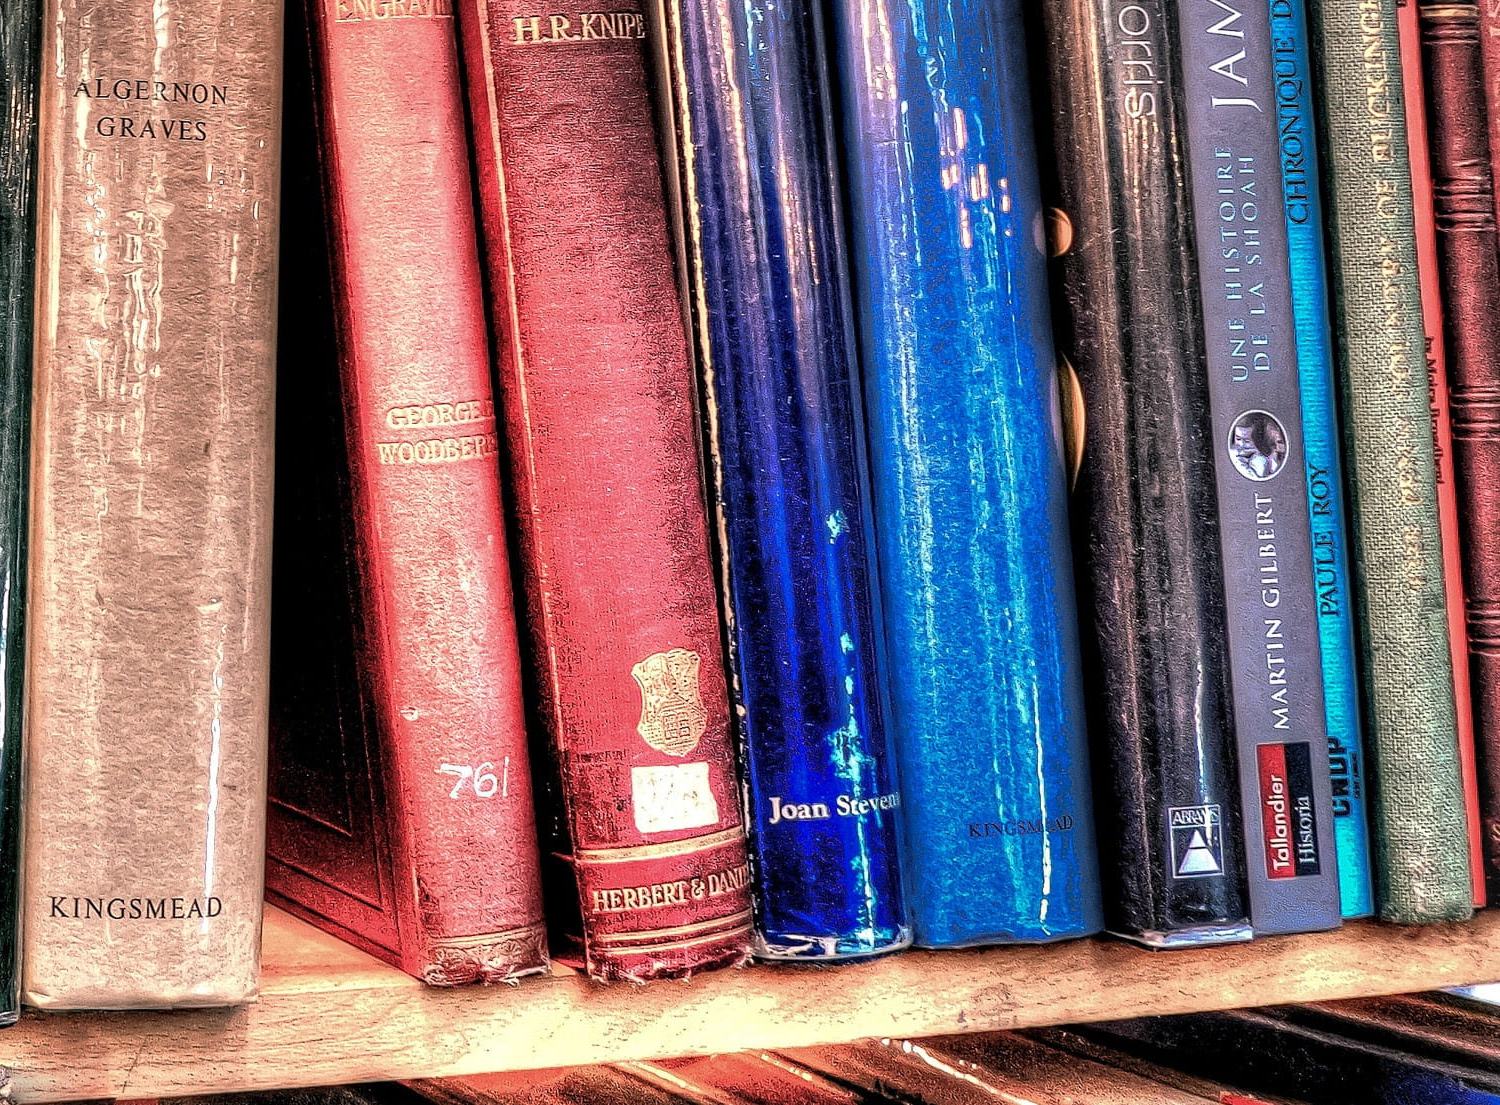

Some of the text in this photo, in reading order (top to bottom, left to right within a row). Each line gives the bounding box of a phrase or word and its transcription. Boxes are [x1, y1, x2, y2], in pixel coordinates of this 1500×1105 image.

[73, 78, 229, 105] ALGERNON
[96, 116, 208, 142] GRAVES
[1274, 36, 1310, 225] CHRONIQUE
[1214, 146, 1250, 383] UNE HISTOIRE
[1237, 156, 1272, 372] DE LA SHOAH
[1308, 462, 1341, 617] PAULE ROY
[1253, 492, 1291, 730] MARTIN GILBERT
[435, 756, 510, 799] 761
[768, 796, 831, 824] Joan
[967, 814, 1075, 839] KINGSMAD
[1265, 774, 1291, 871] Tallandier
[1297, 795, 1317, 865] Historia
[49, 895, 223, 921] KINGSMEAD
[591, 879, 690, 915] HERBERT
[691, 877, 706, 901] &
